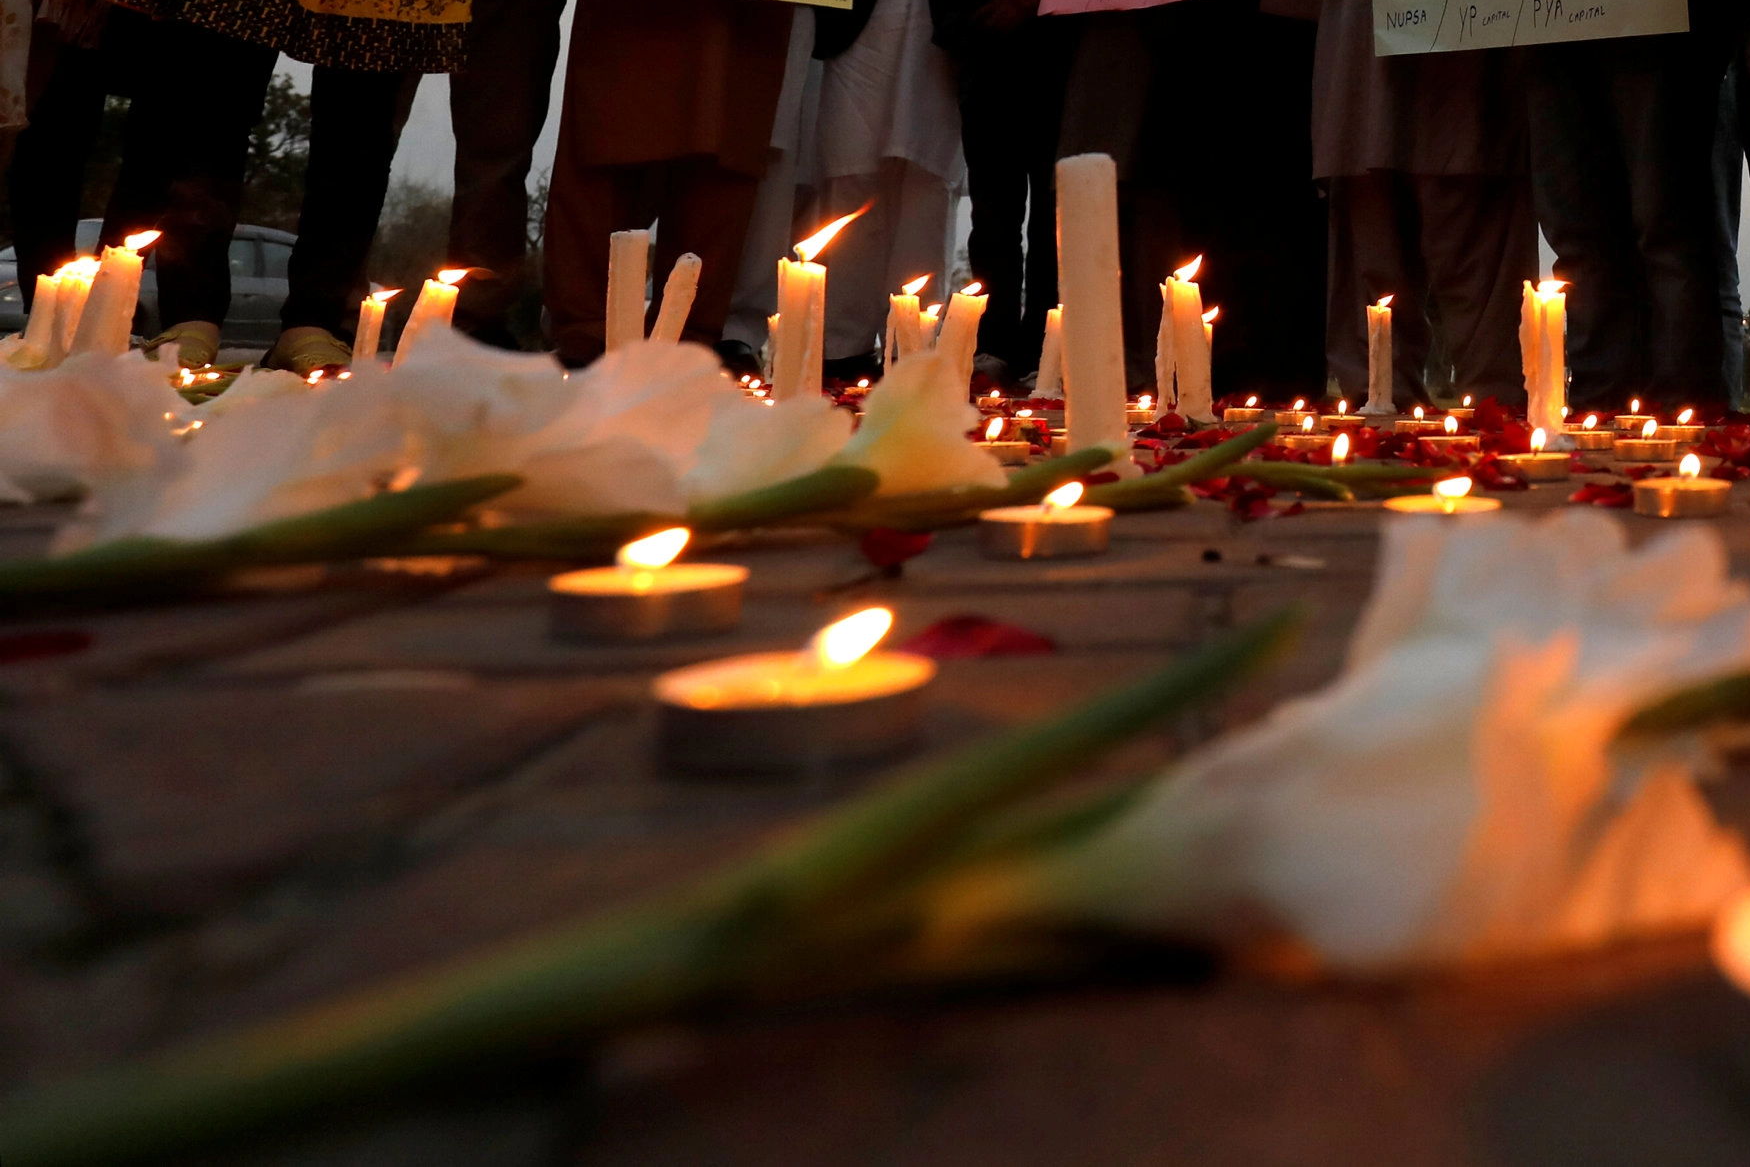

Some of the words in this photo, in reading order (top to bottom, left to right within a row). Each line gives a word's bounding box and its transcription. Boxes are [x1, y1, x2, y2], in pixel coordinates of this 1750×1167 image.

[1387, 11, 1427, 30] NUPSA
[1459, 5, 1477, 42] YP
[1482, 10, 1510, 26] CAPITAL
[1569, 5, 1605, 23] CAPITAL
